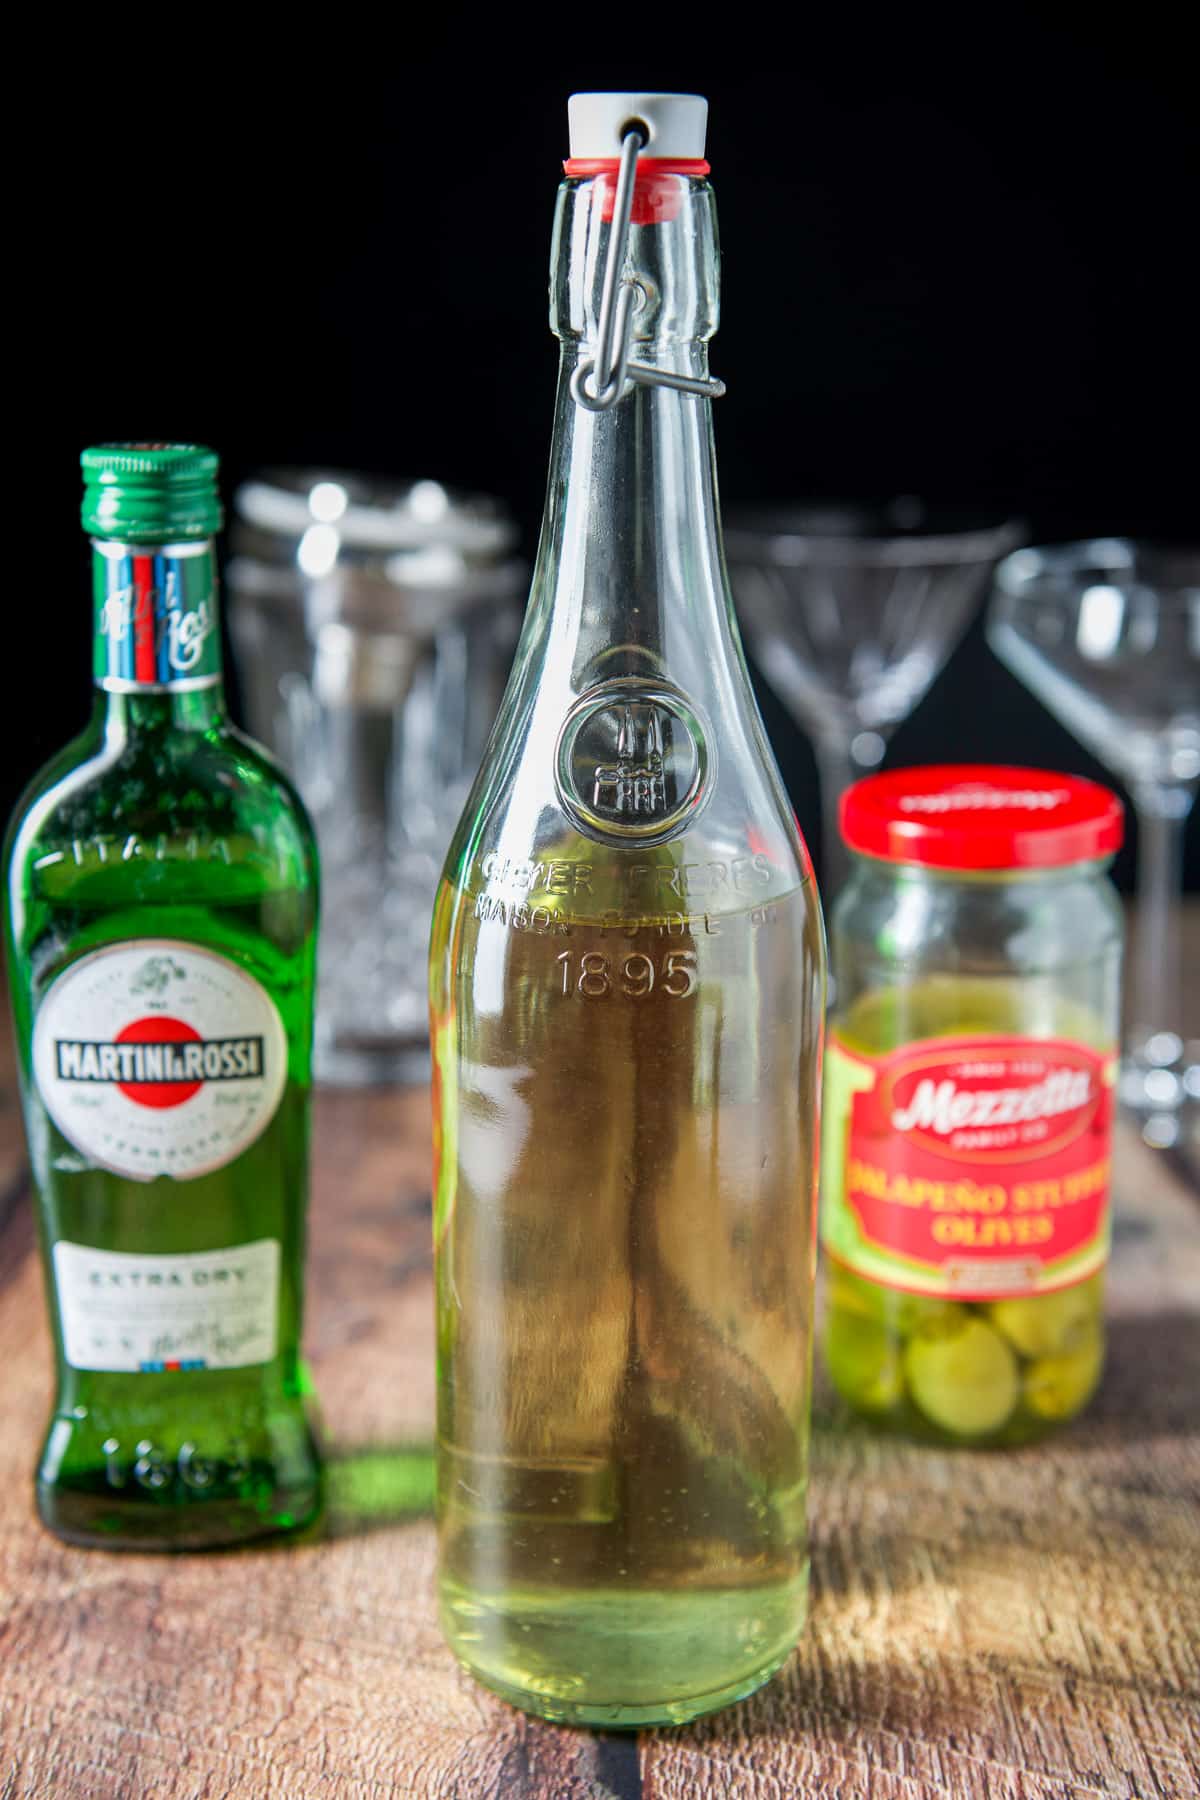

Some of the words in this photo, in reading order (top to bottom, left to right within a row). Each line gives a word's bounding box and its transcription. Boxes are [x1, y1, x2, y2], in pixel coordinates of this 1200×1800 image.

[557, 951, 699, 998] 1895
[58, 1041, 175, 1082] MARTINI
[183, 1039, 261, 1080] ROSSI
[890, 1068, 1090, 1133] Mezzetta
[931, 1213, 1055, 1247] OLIVES
[89, 1270, 182, 1287] EXTRA
[192, 1267, 247, 1286] DRY
